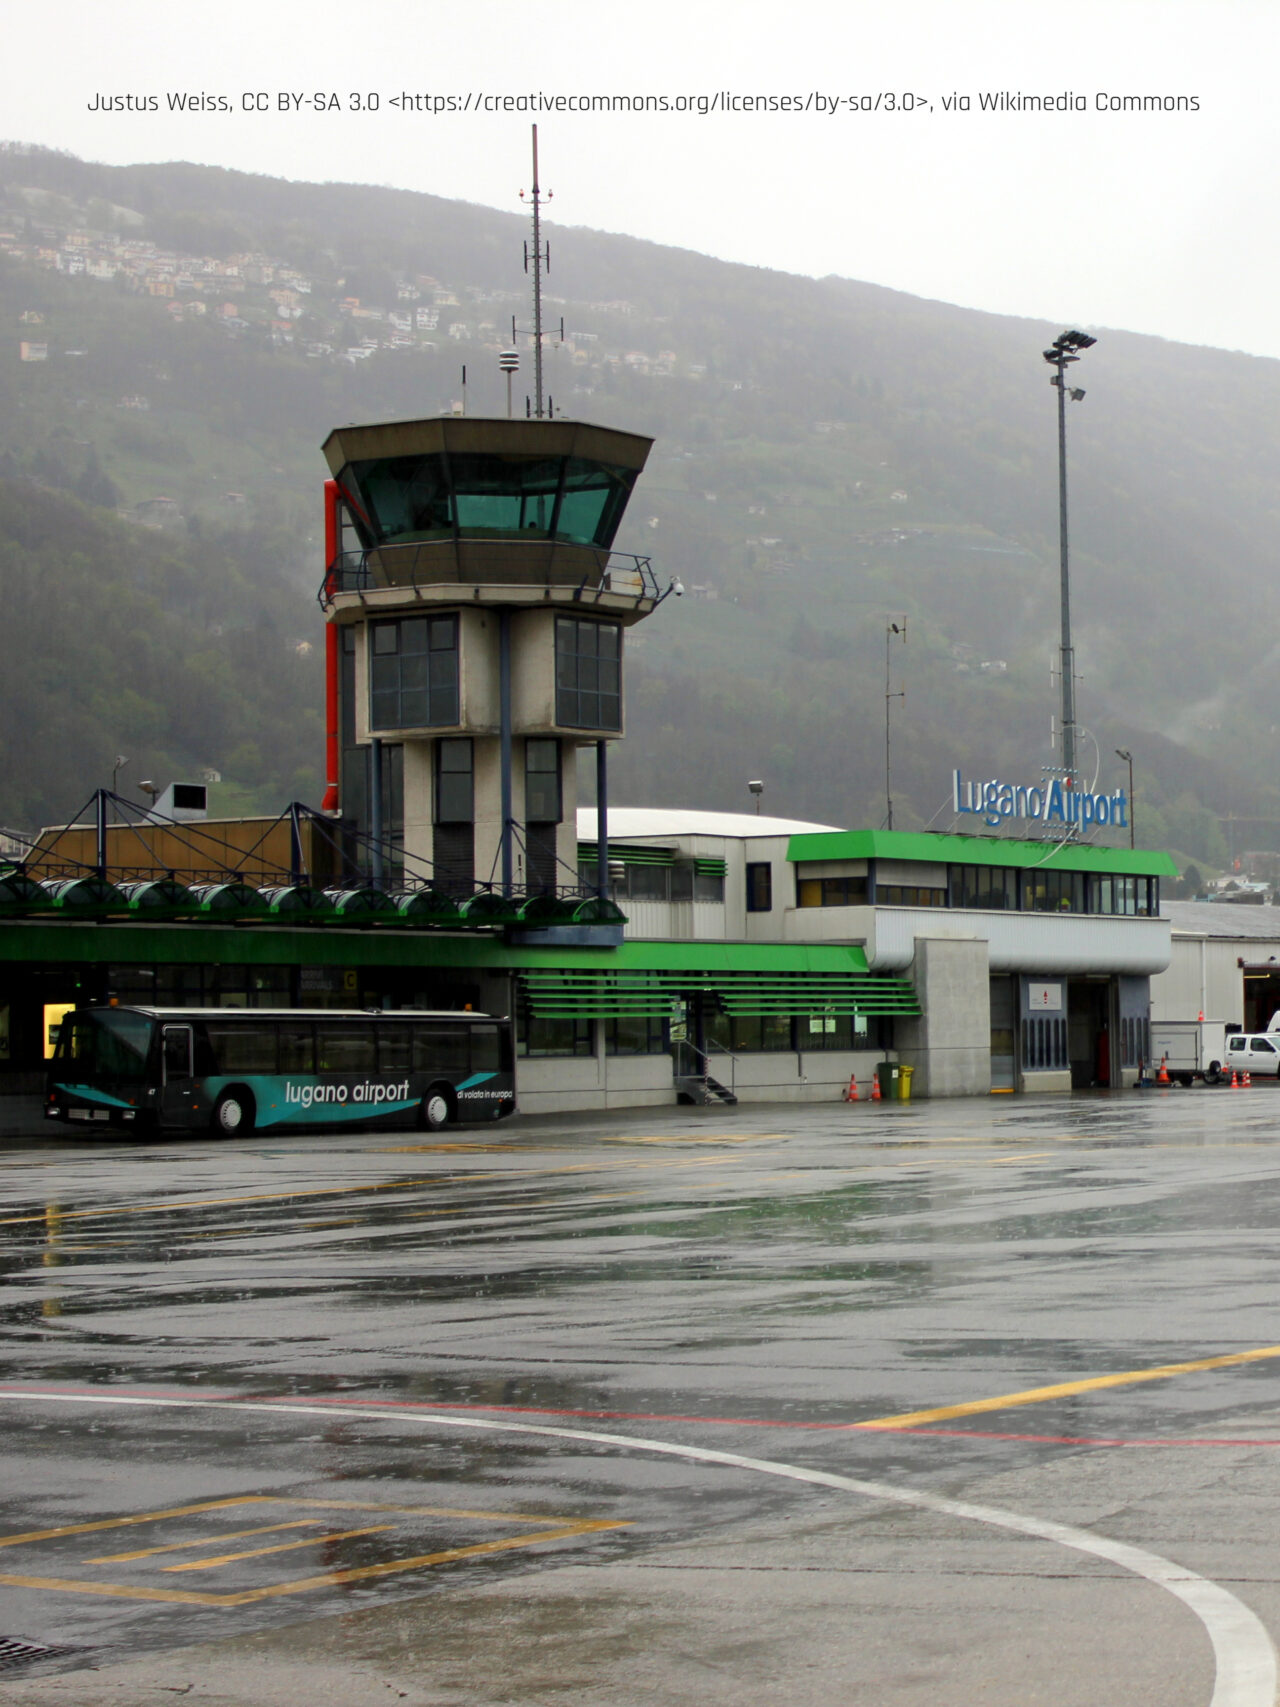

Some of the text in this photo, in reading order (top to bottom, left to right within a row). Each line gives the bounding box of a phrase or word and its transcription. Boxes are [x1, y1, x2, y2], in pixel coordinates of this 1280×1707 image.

[285, 1079, 410, 1108] lugano airport
[491, 1090, 513, 1100] europa
